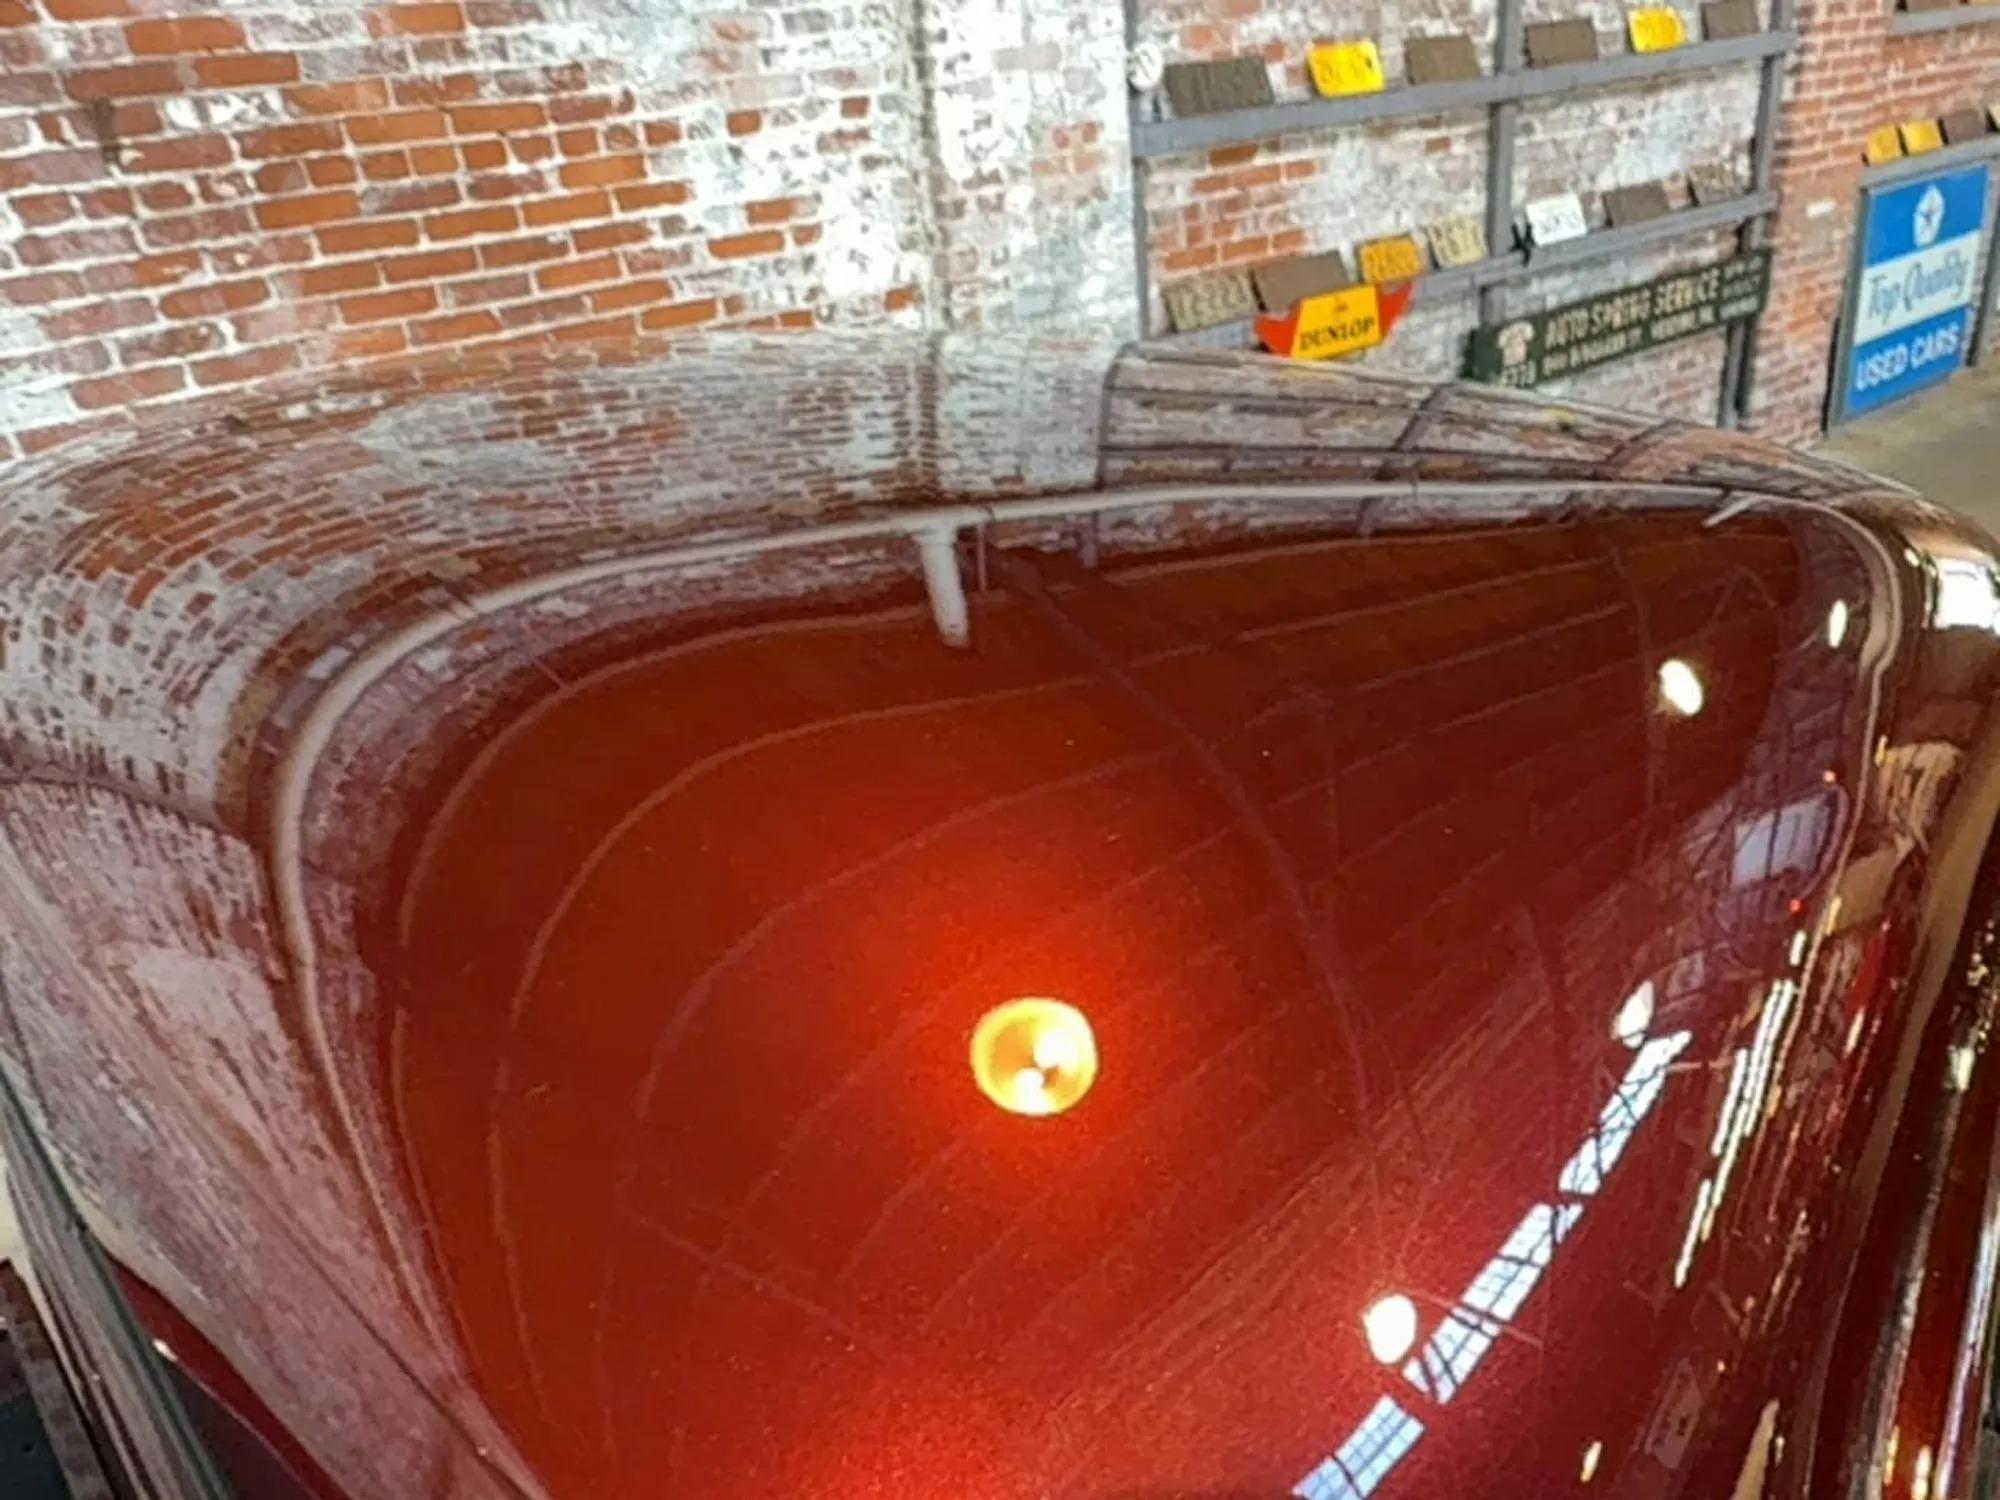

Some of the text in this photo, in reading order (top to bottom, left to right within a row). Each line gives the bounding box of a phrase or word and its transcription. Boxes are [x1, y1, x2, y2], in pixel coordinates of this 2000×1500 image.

[1545, 308, 1588, 348] AUTO
[1654, 268, 1719, 315] SERVICE
[1868, 249, 1969, 325] Top Quality
[1301, 316, 1376, 350] DUNLOP
[1855, 321, 1960, 391] USED CARS
